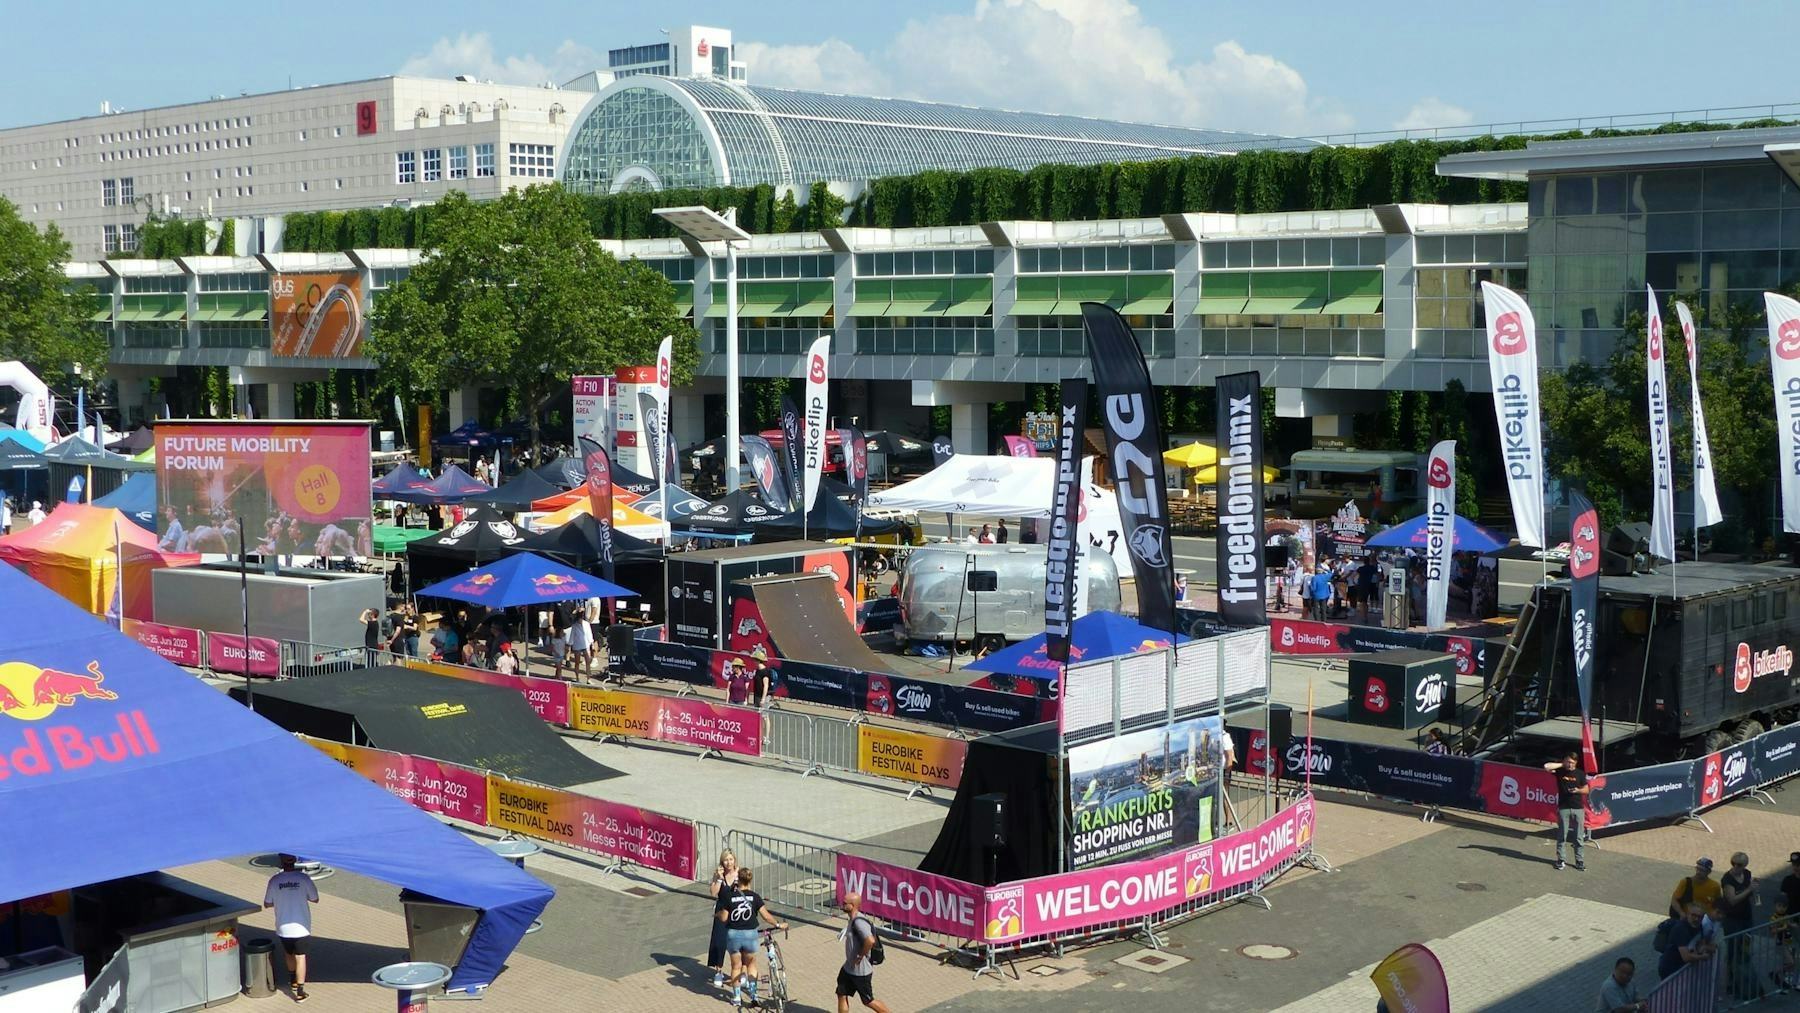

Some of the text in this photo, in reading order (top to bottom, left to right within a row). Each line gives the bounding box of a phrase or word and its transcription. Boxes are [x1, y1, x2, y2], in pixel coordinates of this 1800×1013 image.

[361, 104, 373, 131] 9
[583, 380, 598, 392] F10
[807, 396, 824, 469] bikeflip
[1027, 422, 1056, 435] FISH
[164, 437, 311, 454] FUTURE MOBILITY
[164, 456, 224, 471] FORUM
[300, 473, 329, 494] Hall
[316, 492, 326, 505] 8
[1219, 393, 1257, 604] freedombmx
[1427, 502, 1449, 580] bikeflip
[160, 636, 172, 646] Juni
[173, 638, 188, 648] 2023
[1297, 633, 1331, 647] bikeflip
[156, 646, 184, 659] Frankfurt
[223, 646, 266, 662] EUROBIKE
[1753, 645, 1793, 677] bikeflip
[797, 676, 813, 687] bicycle
[529, 690, 551, 703] 2023
[580, 701, 627, 716] EUROBIKE
[964, 701, 976, 711] Buy
[1005, 706, 1020, 716] bikes
[580, 715, 649, 731] FESTIVAL DAYS
[696, 716, 716, 728] Juni
[718, 719, 741, 733] 2023
[46, 709, 161, 770] Bull
[657, 722, 735, 746] Messe Frankfurt
[872, 741, 923, 761] EUROBIKE
[872, 756, 950, 780] FESTIVAL DAYS
[1378, 764, 1393, 776] Buy
[1393, 766, 1400, 774] &
[1400, 766, 1412, 777] sell
[1413, 769, 1431, 780] used
[1432, 772, 1452, 783] bikes
[422, 775, 442, 790] Juni
[444, 780, 468, 799] 2023
[1526, 785, 1559, 806] bikef
[1611, 791, 1622, 801] The
[1622, 787, 1644, 799] bicycle
[1644, 782, 1683, 794] marketplace
[417, 789, 460, 812] Frankfurt
[500, 793, 548, 815] EUROBIKE
[500, 809, 574, 837] FESTIVAL DAYS
[1073, 809, 1174, 853] SHOPPING NR.1
[583, 828, 667, 862] Messe Frankfurt
[623, 824, 644, 840] Juni
[647, 829, 673, 848] 2023
[1073, 854, 1088, 866] NUR
[1087, 852, 1095, 862] 12
[1095, 849, 1109, 861] MIN.
[1110, 846, 1118, 856] ZU
[1118, 842, 1131, 854] FUSS
[1131, 838, 1145, 850] VON
[1145, 835, 1157, 845] DER
[1156, 831, 1173, 843] MESSE
[1186, 849, 1212, 863] EUROBIKE
[1219, 820, 1294, 877] WELCOME
[841, 867, 975, 927] WELCOME
[985, 889, 1023, 901] EUROBIKE
[1035, 866, 1178, 922] WELCOME
[211, 940, 228, 952] Red
